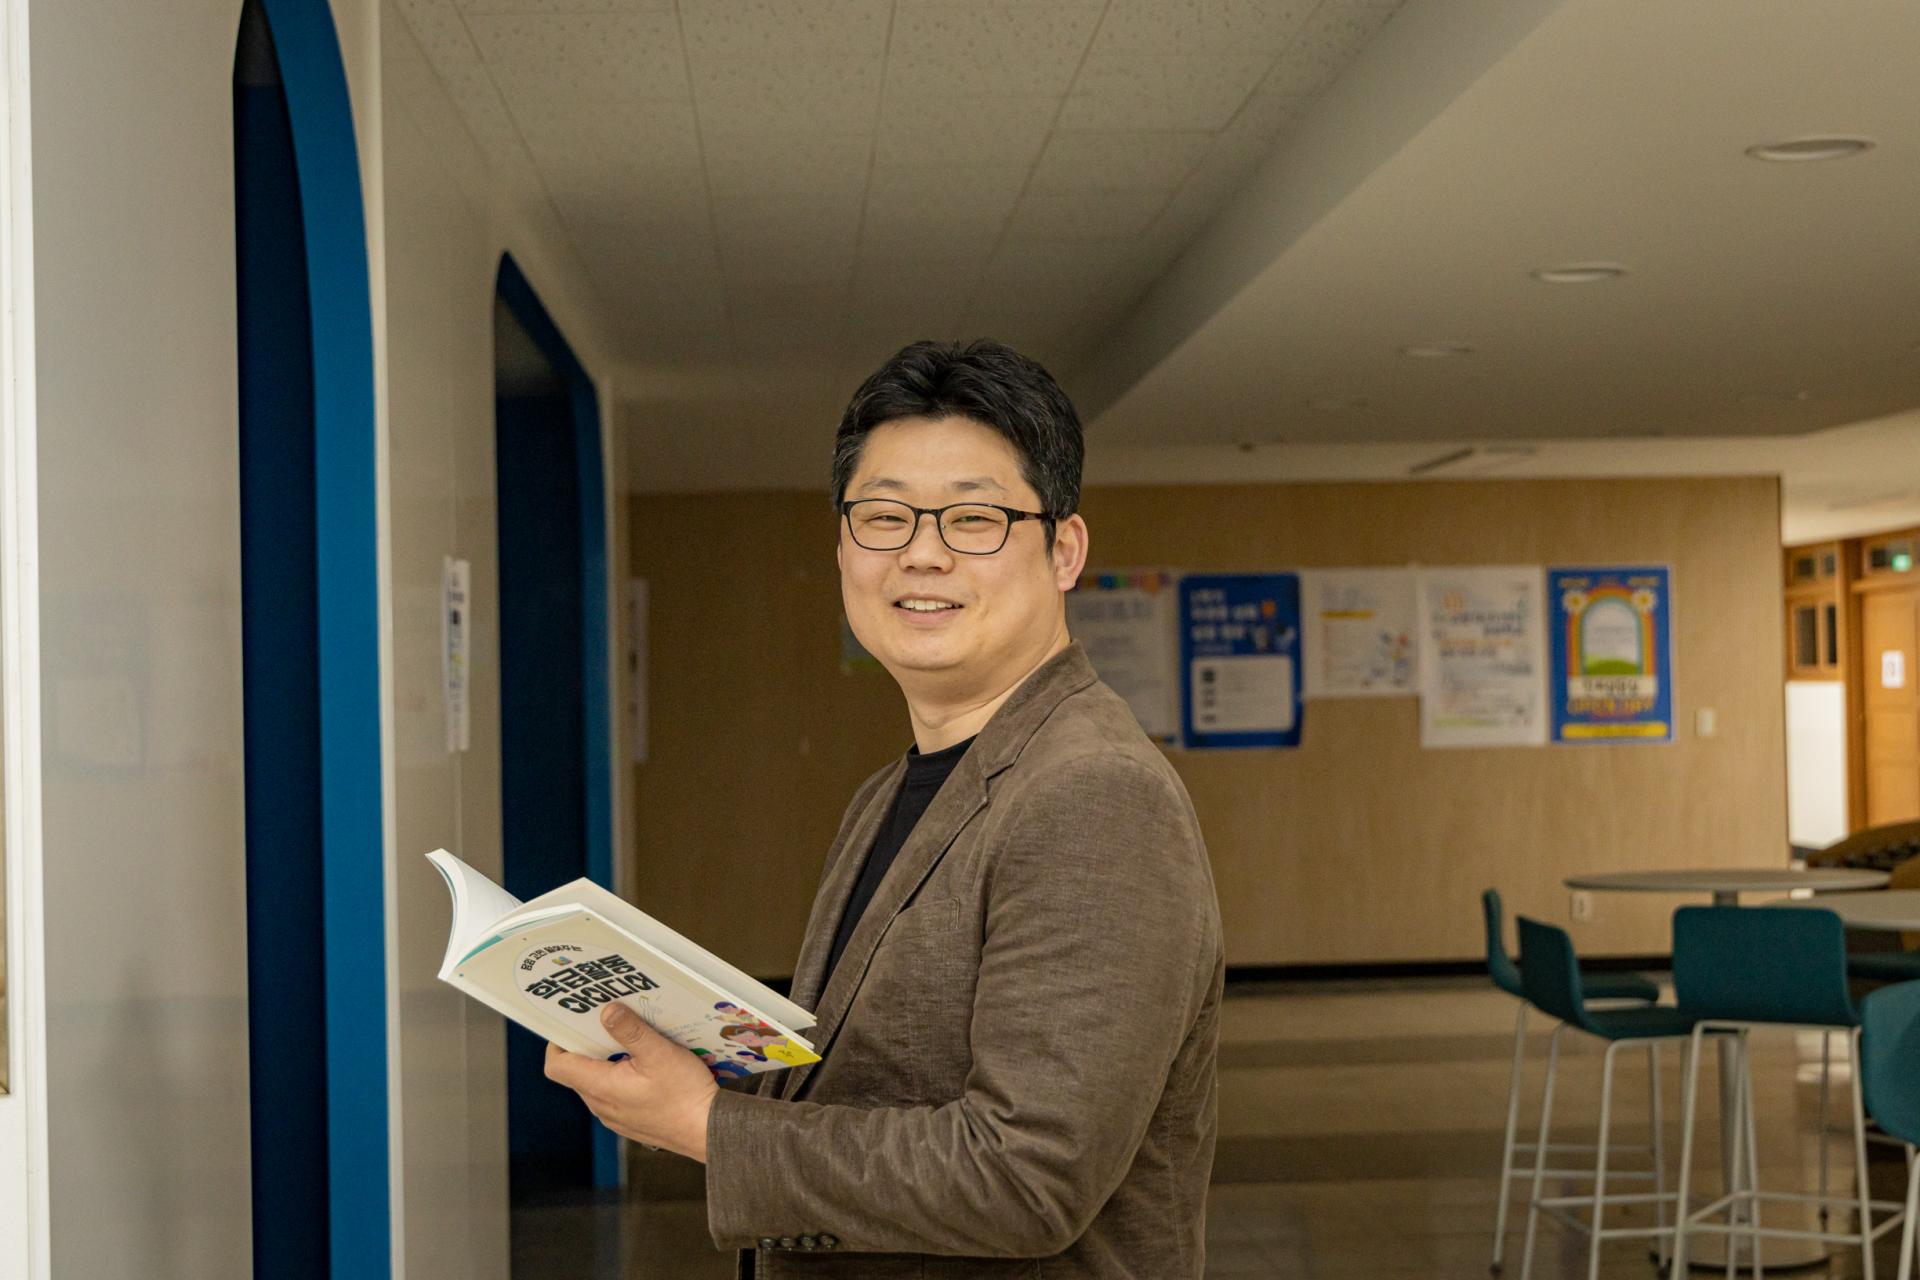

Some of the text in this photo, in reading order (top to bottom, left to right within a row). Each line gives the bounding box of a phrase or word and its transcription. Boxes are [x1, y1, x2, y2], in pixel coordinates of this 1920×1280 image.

[521, 957, 536, 971] 담임
[529, 949, 548, 960] 고민
[525, 954, 636, 999] 학급활동
[558, 972, 660, 1013] 아이디어
